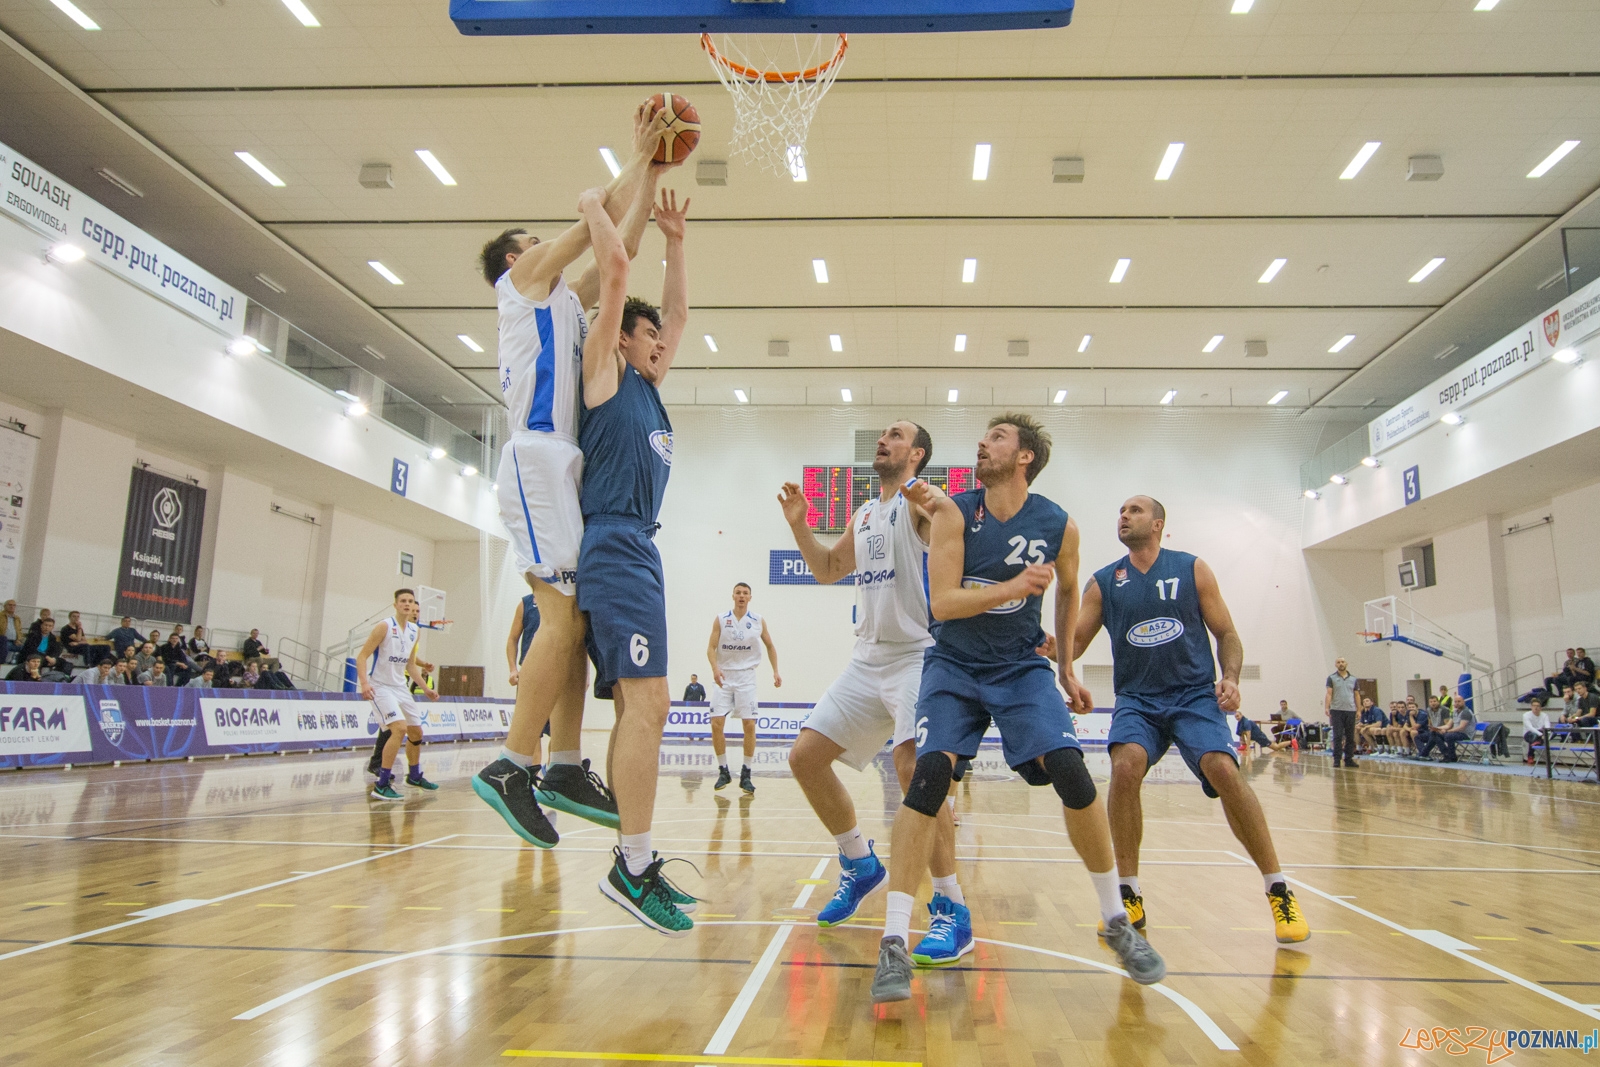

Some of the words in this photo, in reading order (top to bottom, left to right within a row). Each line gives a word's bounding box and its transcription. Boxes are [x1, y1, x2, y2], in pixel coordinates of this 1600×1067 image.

[11, 161, 71, 211] SQUASH
[6, 190, 67, 235] ERGOWIOSŁA
[81, 216, 234, 320] cspp.put.poznan.pl
[1438, 331, 1535, 404] cspp.put.poznan.pl
[396, 463, 406, 491] 3
[1406, 469, 1416, 499] 3
[132, 551, 163, 567] Książki,
[867, 534, 885, 560] 12
[1004, 535, 1048, 567] 25
[130, 566, 152, 578] które
[153, 571, 165, 583] się
[165, 575, 185, 585] czyta
[1156, 577, 1180, 601] 17
[629, 633, 650, 667] 6
[134, 717, 197, 728] www.basket.poznan.pl
[215, 707, 280, 727] BIOFARM
[302, 714, 317, 730] PBG
[324, 714, 338, 730] PBG
[345, 713, 359, 729] PBG
[463, 709, 493, 722] BIOFARM
